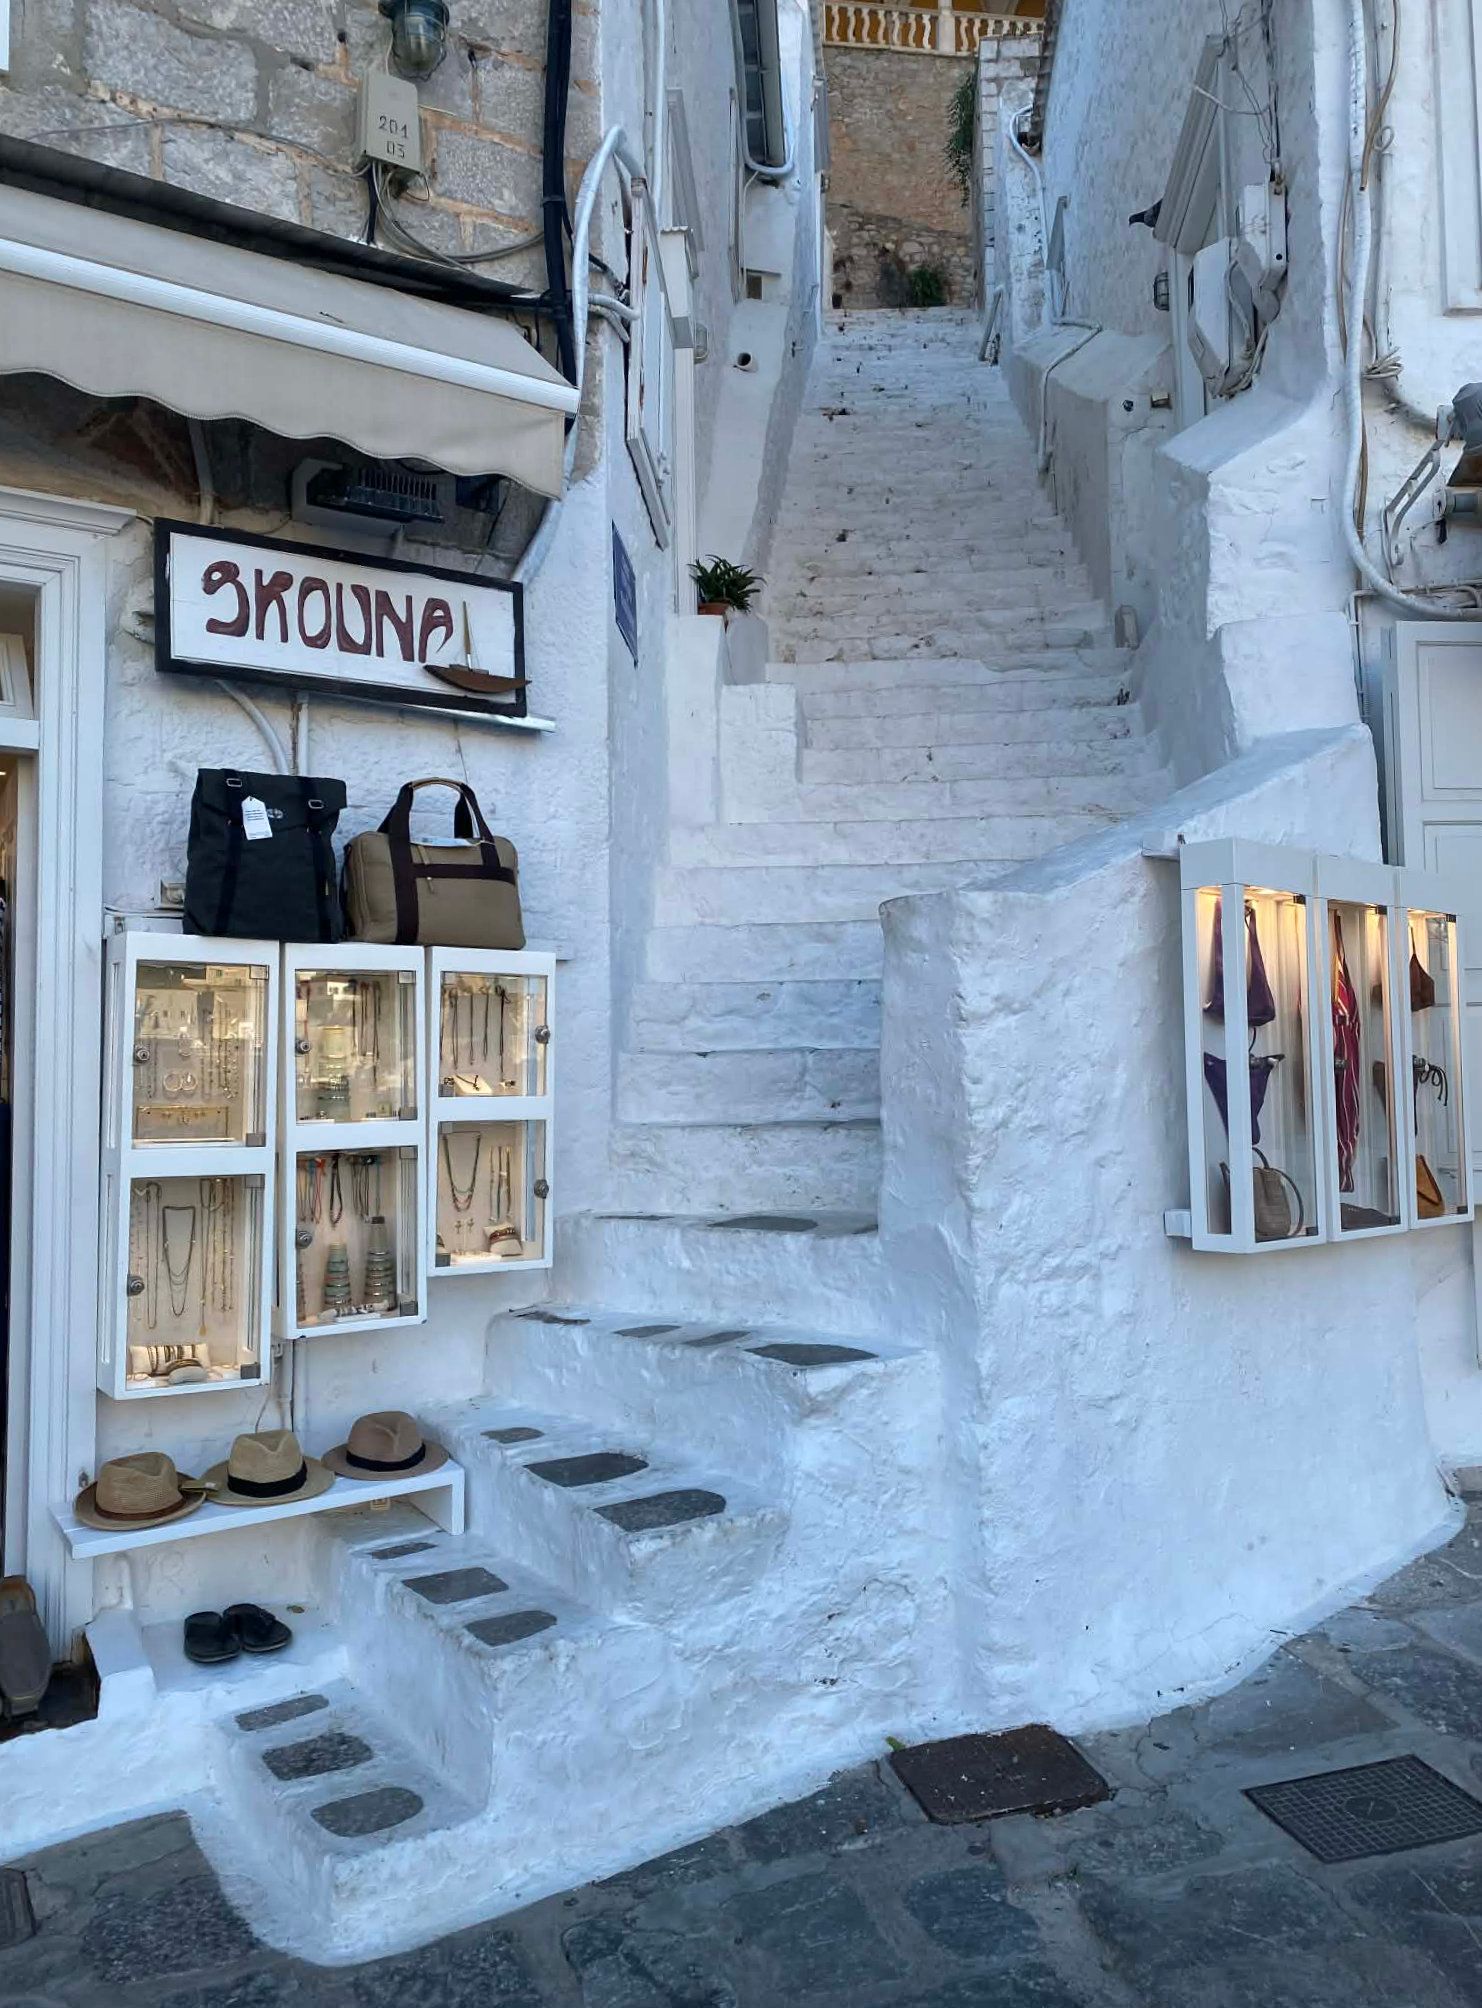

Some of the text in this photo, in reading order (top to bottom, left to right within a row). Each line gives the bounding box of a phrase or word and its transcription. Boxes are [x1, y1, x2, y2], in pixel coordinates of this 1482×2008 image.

[379, 115, 408, 139] 201
[387, 140, 405, 158] 03
[201, 560, 454, 664] SKOUNA
